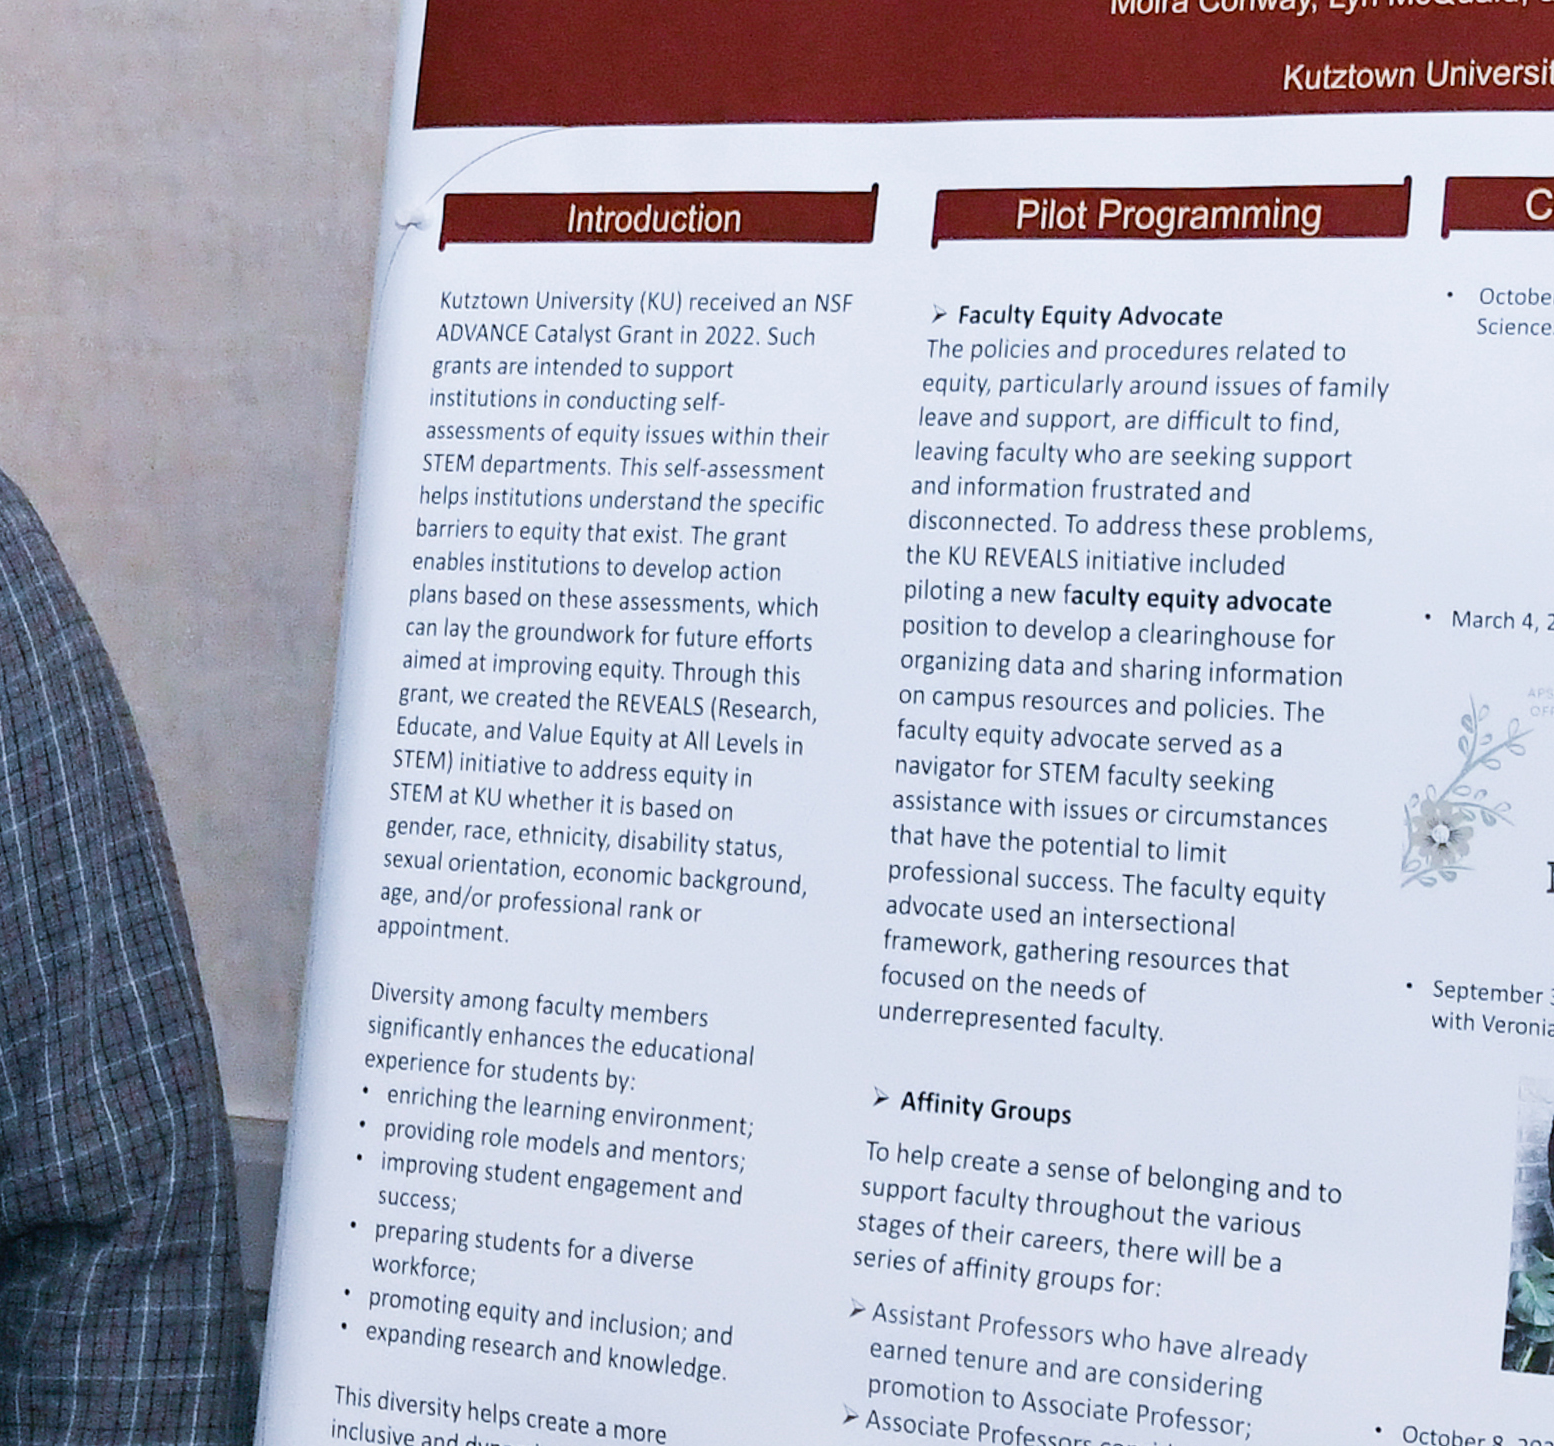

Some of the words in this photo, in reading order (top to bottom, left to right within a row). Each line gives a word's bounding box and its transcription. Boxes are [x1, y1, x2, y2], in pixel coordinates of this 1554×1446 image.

[1284, 64, 1415, 90] Kutztown
[568, 203, 741, 233] Introduction
[1017, 199, 1088, 229] Pilot
[1099, 197, 1322, 231] Programming
[441, 291, 528, 309] Kutztown
[536, 291, 634, 314] University
[640, 291, 682, 315] (KU)
[689, 292, 775, 312] received
[782, 298, 806, 312] an
[815, 294, 853, 313] NSF
[959, 304, 1035, 329] Faculty
[1042, 305, 1112, 329] Equity
[1118, 305, 1223, 326] Advocate
[927, 338, 963, 358] The
[971, 338, 1049, 362] policies
[1057, 339, 1098, 359] and
[1105, 340, 1228, 364] procedures
[1236, 340, 1315, 361] related
[1324, 343, 1346, 361] to
[432, 358, 491, 379] grants
[497, 361, 528, 375] are
[535, 356, 622, 377] intended
[630, 360, 649, 377] to
[655, 361, 734, 382] support
[1452, 610, 1515, 629] March
[1522, 612, 1538, 633] 4,
[372, 982, 454, 1010] Diversity
[460, 993, 529, 1017] among
[536, 993, 604, 1023] faculty
[611, 1004, 708, 1027] members
[901, 1091, 984, 1121] Affinity
[991, 1099, 1071, 1128] Groups
[384, 1122, 474, 1149] providing
[482, 1128, 519, 1149] role
[526, 1134, 599, 1156] models
[606, 1140, 645, 1160] and
[652, 1147, 745, 1174] mentors;
[865, 1409, 970, 1440] Associate
